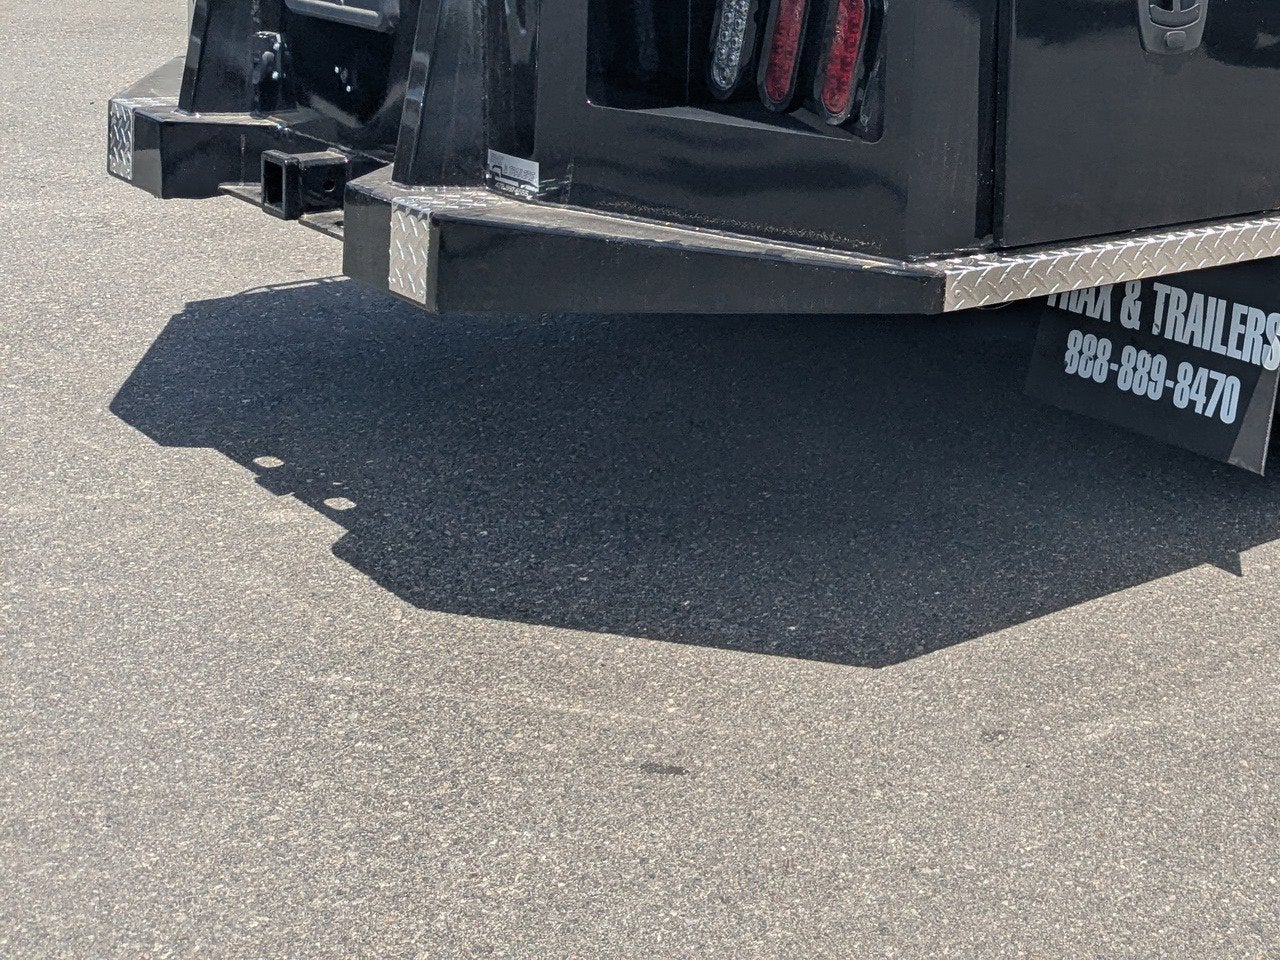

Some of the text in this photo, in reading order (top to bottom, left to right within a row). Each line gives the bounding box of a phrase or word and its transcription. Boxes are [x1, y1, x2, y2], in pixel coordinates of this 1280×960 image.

[1047, 284, 1113, 323] AX
[1120, 280, 1142, 331] &
[1064, 329, 1241, 425] 888-889-8470
